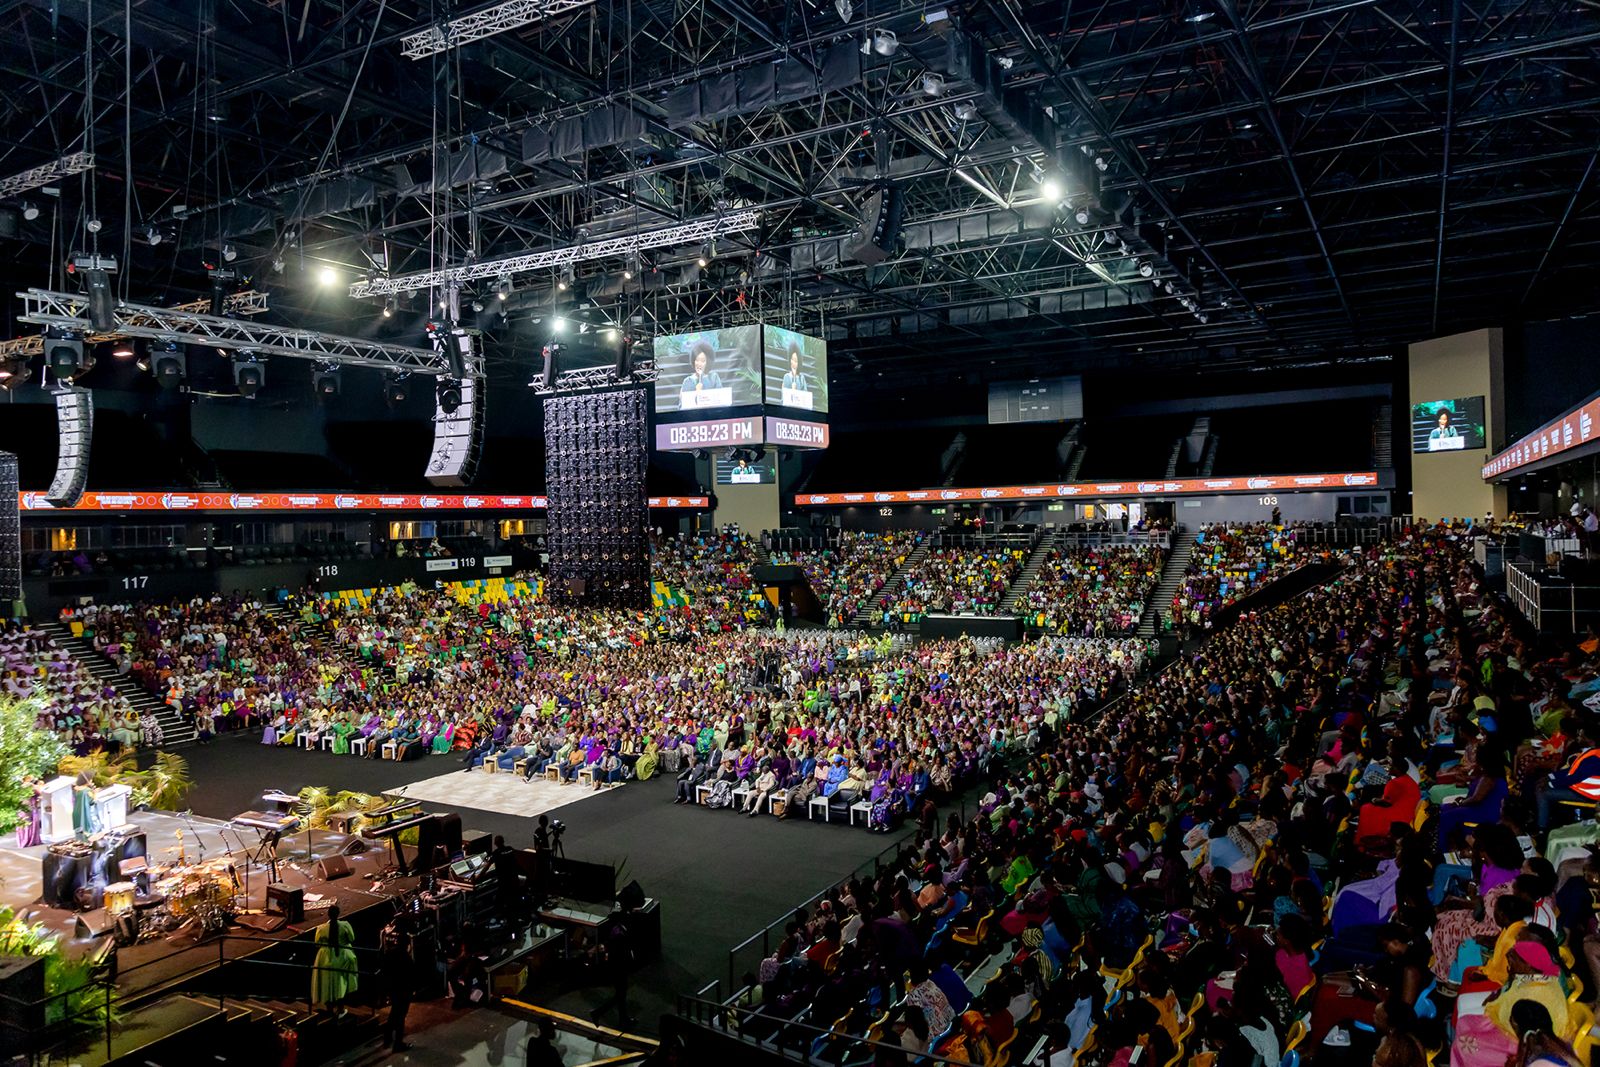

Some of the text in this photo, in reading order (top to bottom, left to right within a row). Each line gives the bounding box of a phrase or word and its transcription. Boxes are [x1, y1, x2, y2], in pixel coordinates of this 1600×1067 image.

[670, 421, 752, 444] 08:39:23 PM
[776, 422, 824, 444] 08:39:23 PM
[1258, 496, 1278, 506] 103
[879, 508, 892, 516] 122
[460, 557, 476, 567] 119
[318, 565, 338, 577] 118
[122, 576, 149, 590] 117
